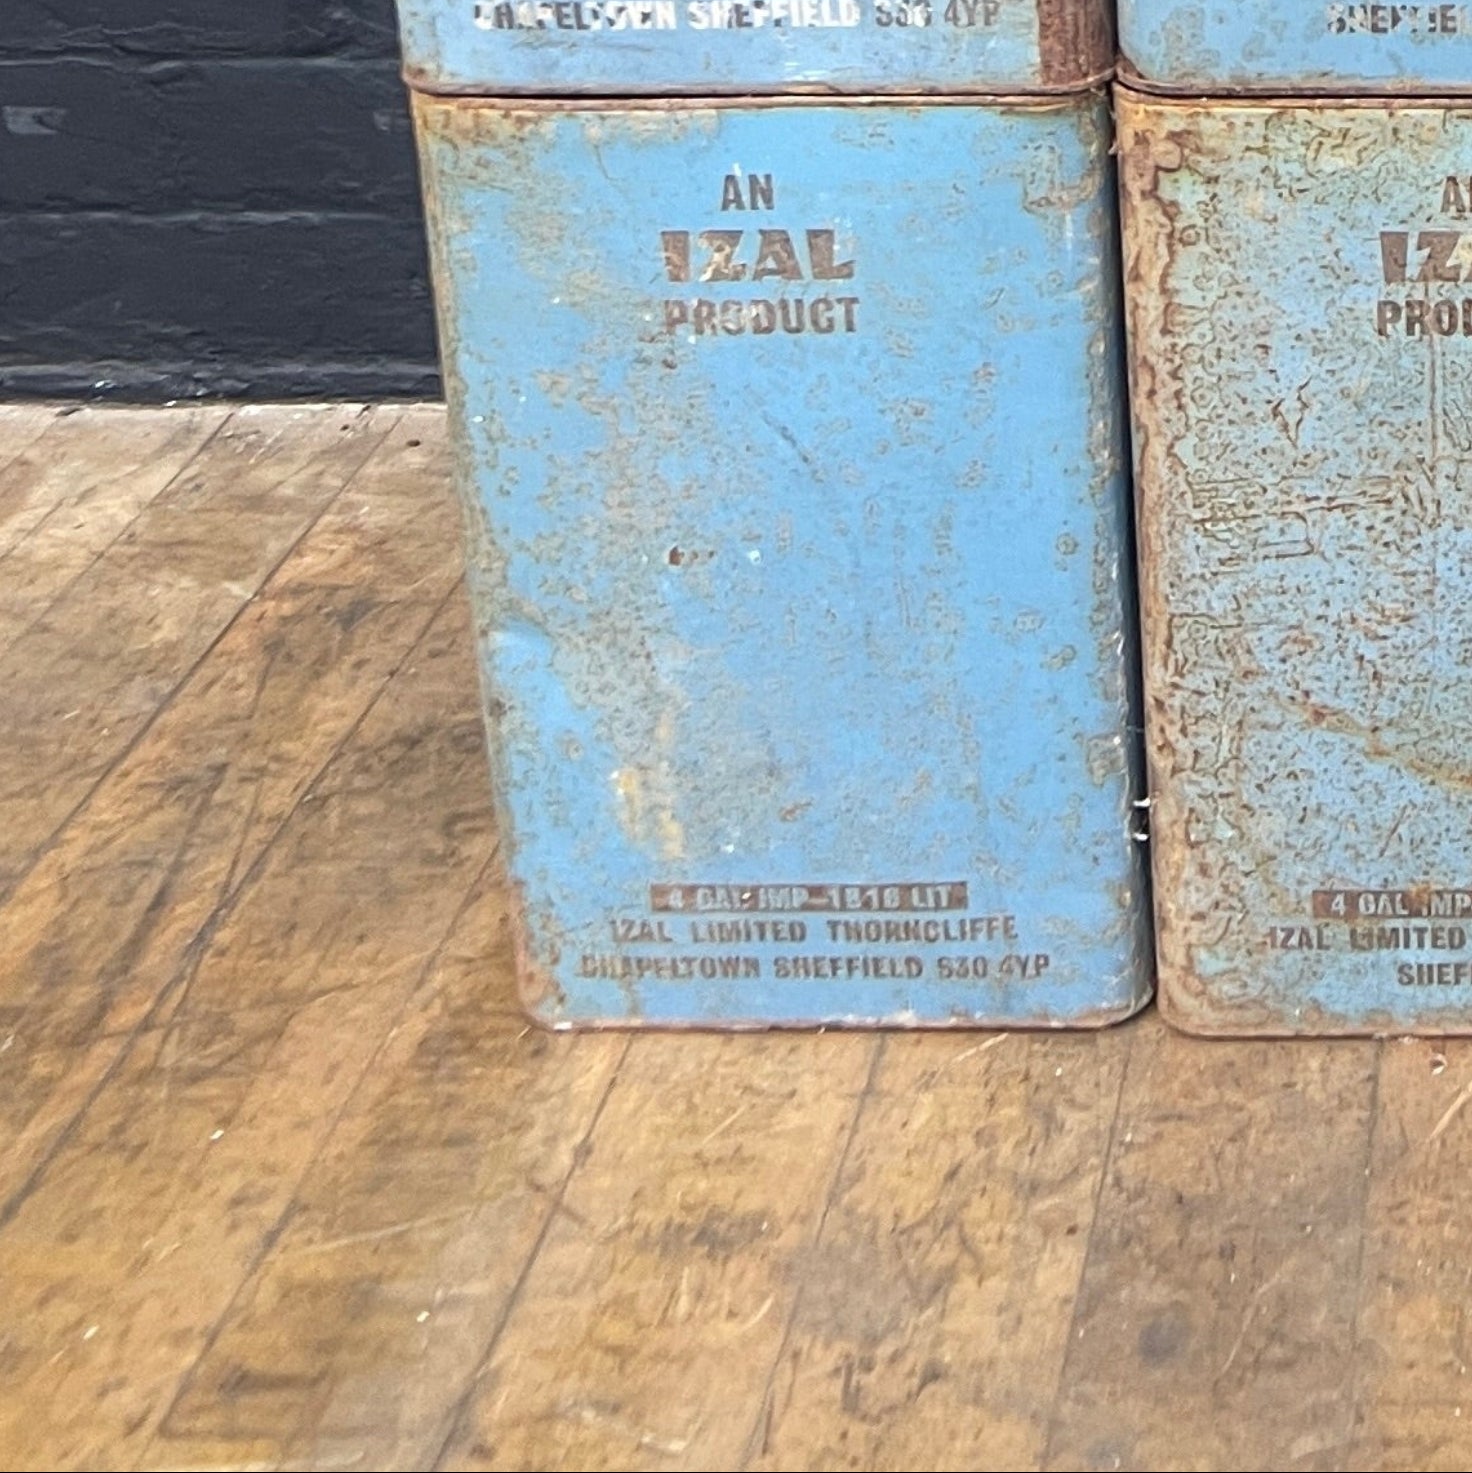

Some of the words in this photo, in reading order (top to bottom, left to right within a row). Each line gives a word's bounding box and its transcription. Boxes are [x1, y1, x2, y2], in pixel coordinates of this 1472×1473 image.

[720, 174, 774, 210] AN
[661, 229, 855, 281] IZAL
[664, 297, 859, 335] PRODUCT
[911, 885, 951, 908] LIT
[1331, 893, 1346, 915] 4
[1358, 893, 1409, 915] GAL
[610, 919, 672, 943] IZAL
[691, 920, 806, 943] LIMITED
[827, 916, 1018, 943] THORNCLIFFE
[1269, 927, 1331, 950] IZAL
[1350, 927, 1466, 950] LIMITED
[580, 956, 760, 979] CHAPELTOWN
[773, 956, 923, 979] SHEFFIELD
